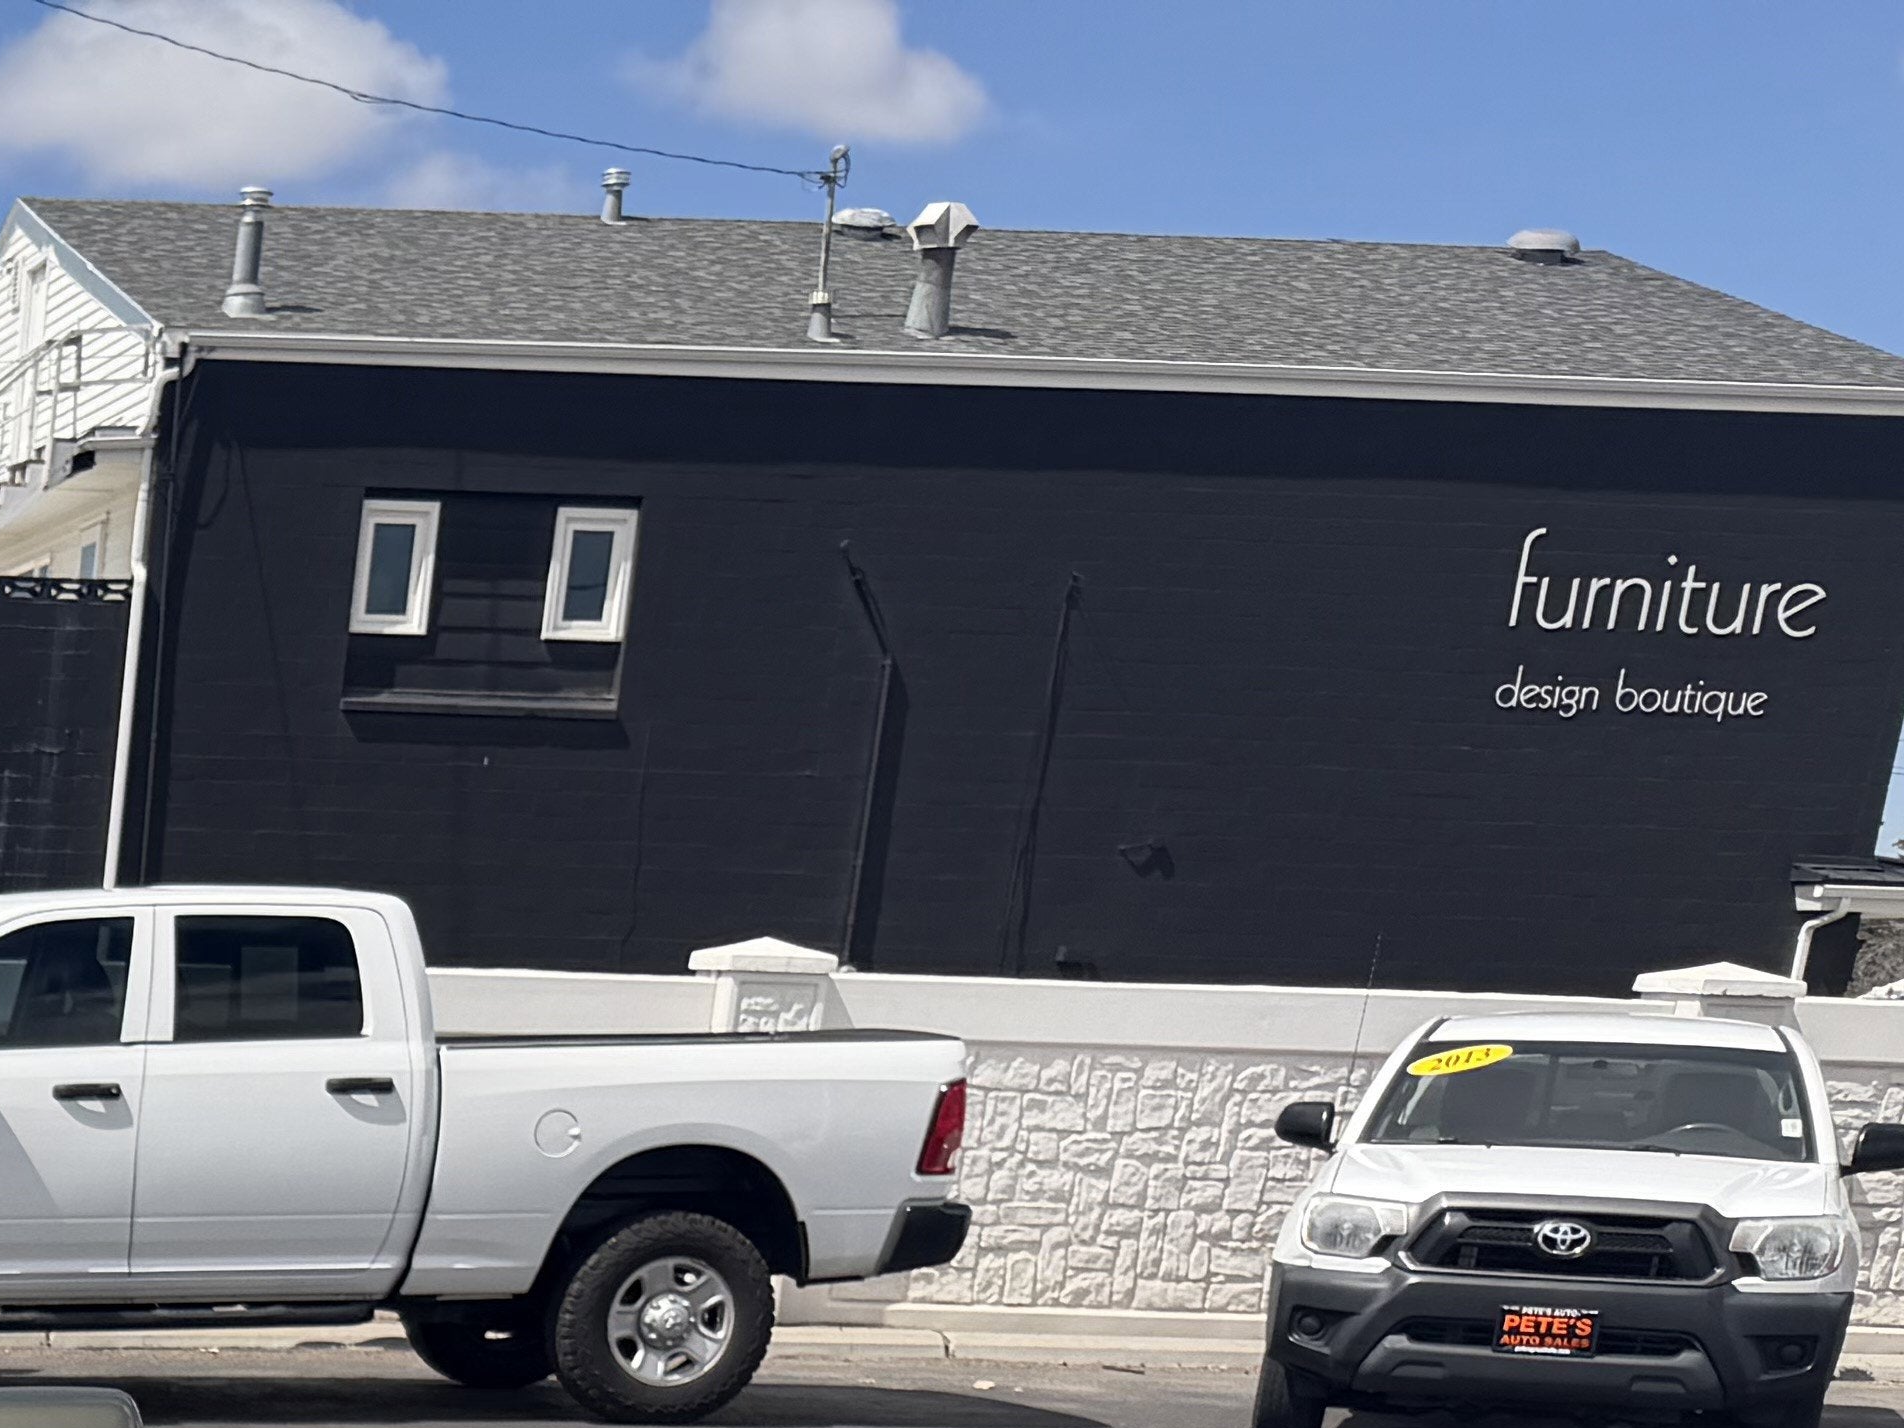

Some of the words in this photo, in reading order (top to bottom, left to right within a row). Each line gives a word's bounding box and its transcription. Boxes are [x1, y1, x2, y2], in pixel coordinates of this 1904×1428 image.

[1507, 527, 1827, 639] furniture
[1494, 664, 1600, 719] design
[1615, 668, 1769, 723] boutique
[1428, 1046, 1492, 1072] 2013
[1502, 1314, 1593, 1336] PETE'S
[1499, 1334, 1540, 1346] AUTO
[1543, 1336, 1590, 1349] SALES
